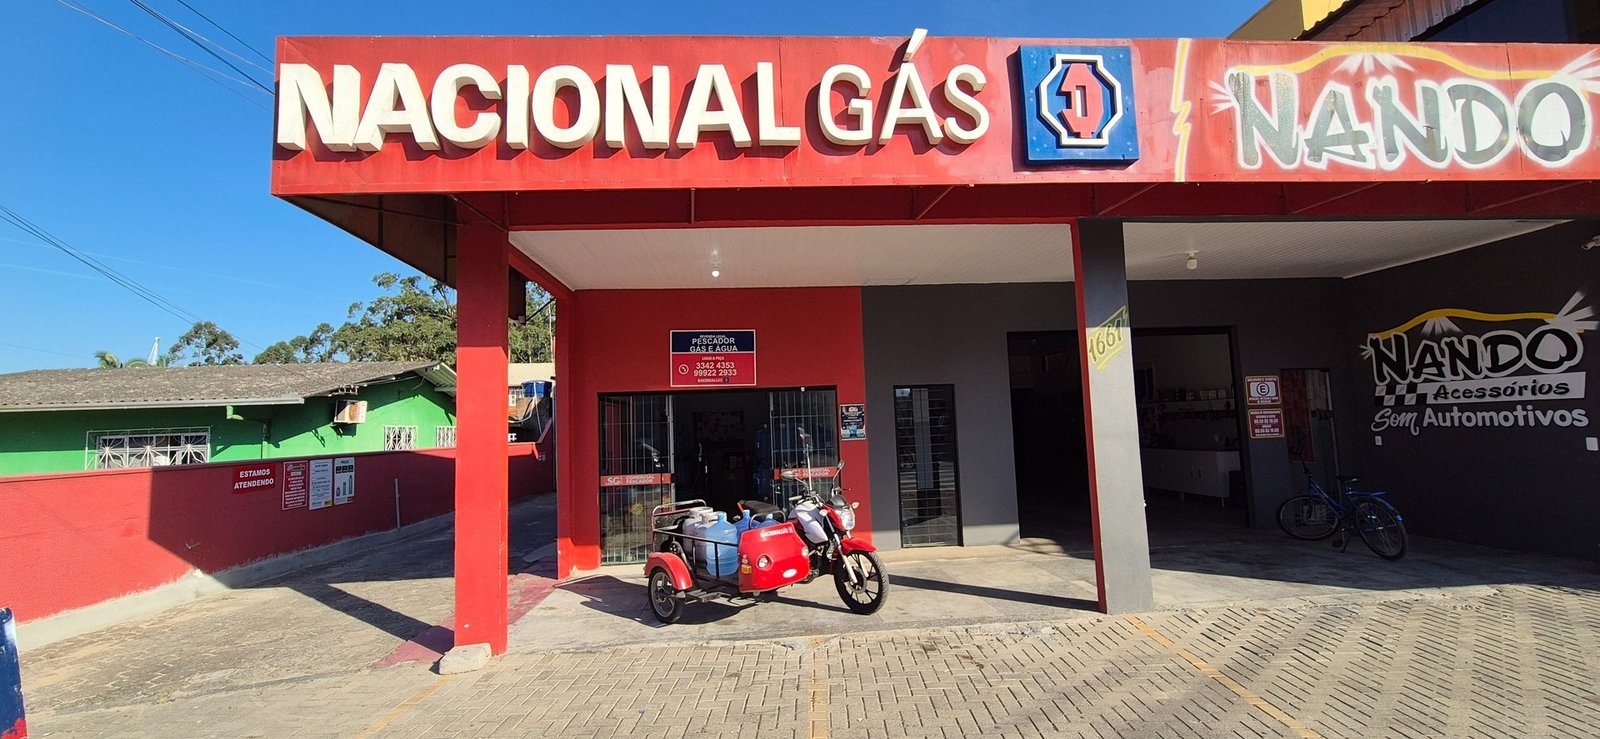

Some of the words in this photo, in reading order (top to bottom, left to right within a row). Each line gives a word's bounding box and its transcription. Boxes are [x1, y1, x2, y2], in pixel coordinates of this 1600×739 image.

[277, 62, 801, 153] NACIONAL
[817, 28, 990, 146] GÁS
[1226, 70, 1589, 167] NANDO
[689, 344, 707, 352] GÁS
[715, 343, 738, 352] ÁGUA
[691, 337, 735, 345] PESCADOR
[1088, 317, 1123, 362] 1661
[1368, 326, 1581, 384] NANDO
[693, 369, 717, 377] 99922
[716, 361, 735, 369] 4353
[1432, 379, 1570, 401] Acessórios
[1371, 408, 1419, 436] Som
[1422, 404, 1590, 427] Automotivos
[240, 469, 270, 478] ESTAMOS
[233, 478, 274, 490] ATENDENDO
